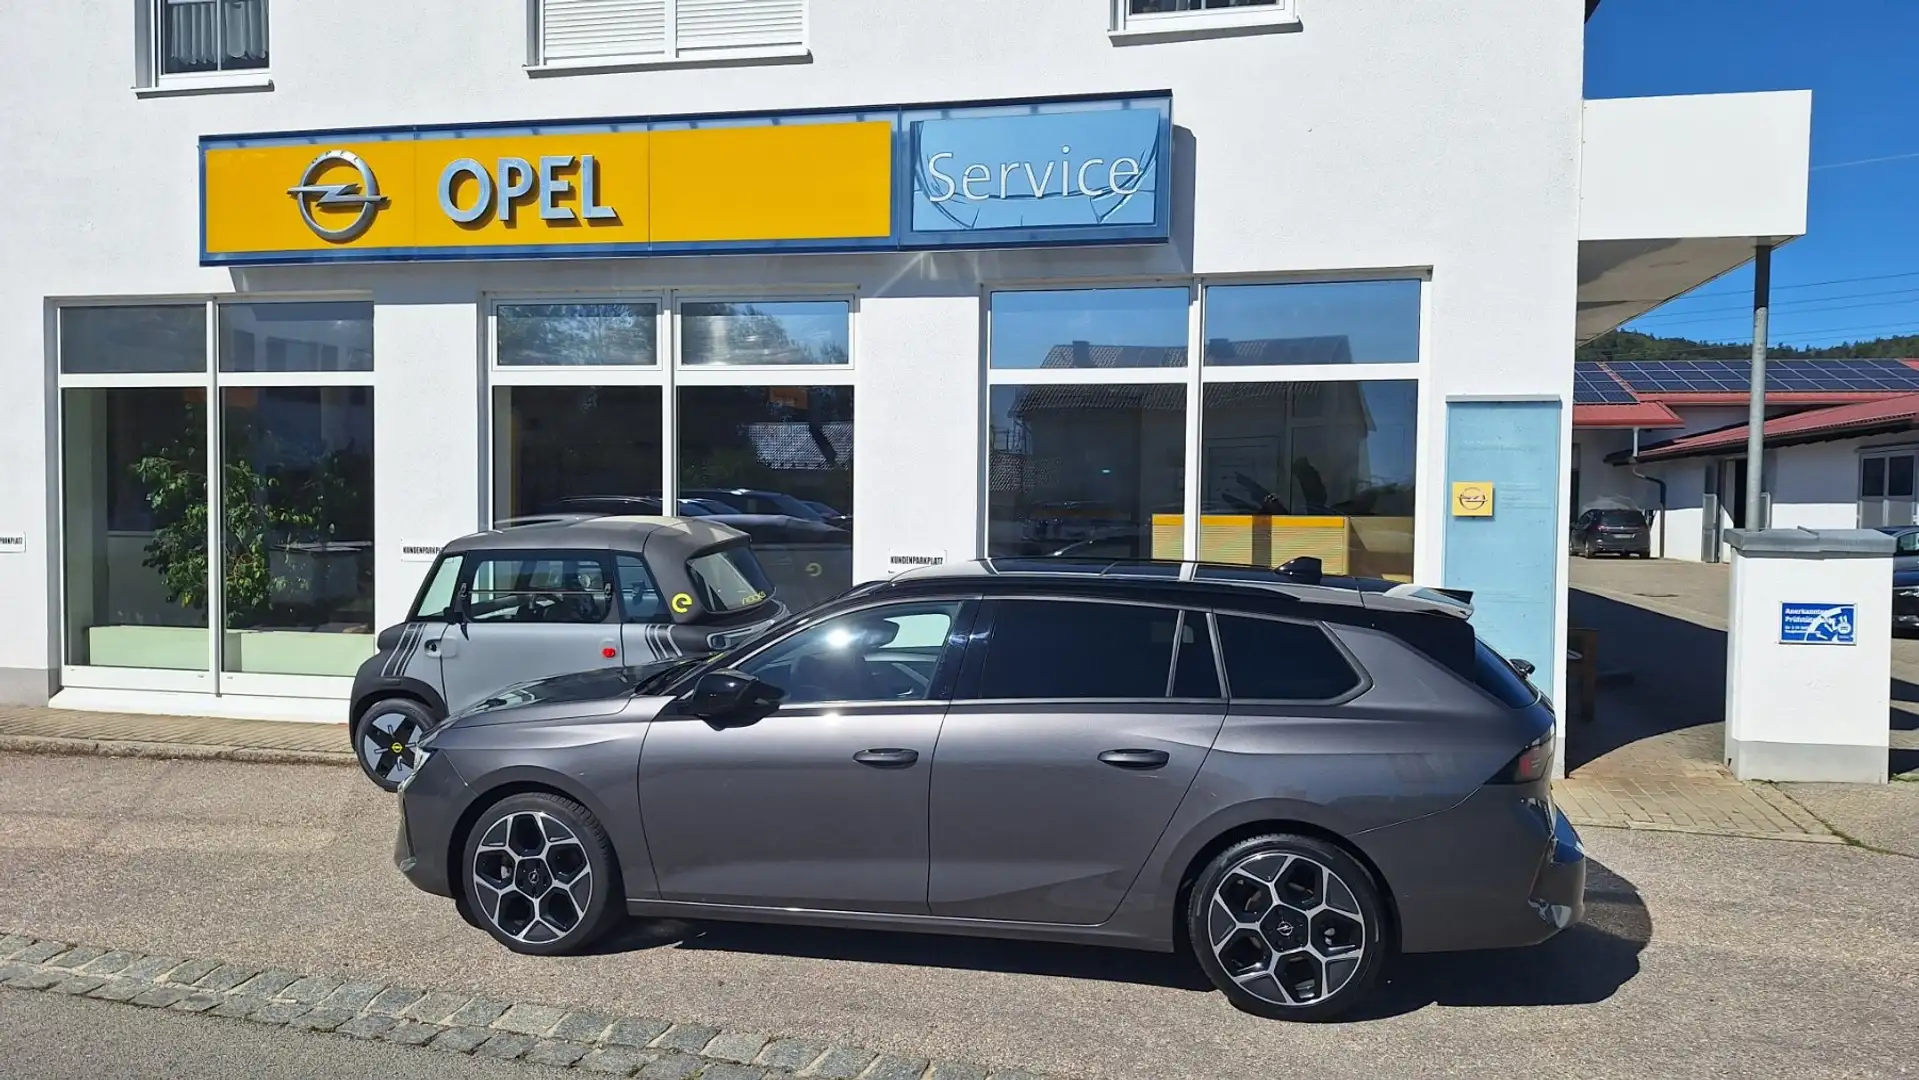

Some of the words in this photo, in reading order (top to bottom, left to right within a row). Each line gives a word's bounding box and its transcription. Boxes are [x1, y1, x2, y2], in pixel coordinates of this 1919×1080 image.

[437, 155, 618, 223] OPEL
[928, 144, 1141, 202] Service
[890, 556, 943, 565] KUNDENPARKPLATZ
